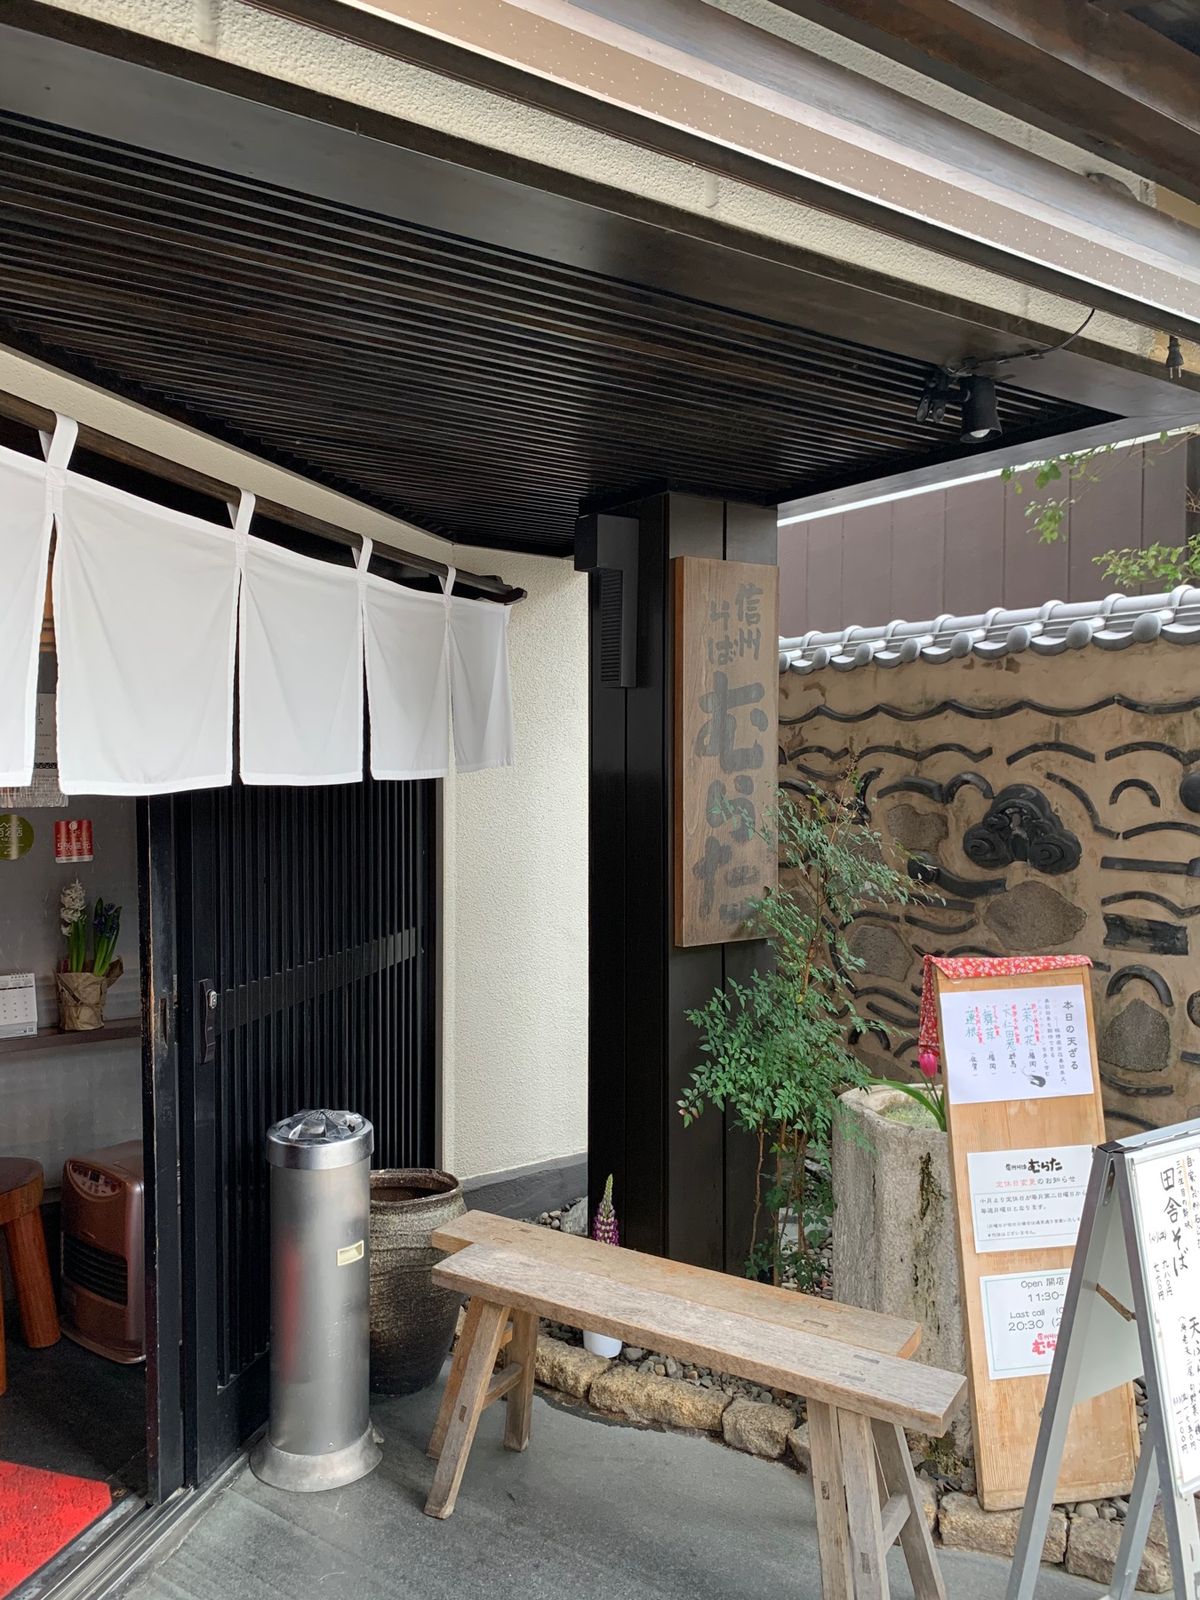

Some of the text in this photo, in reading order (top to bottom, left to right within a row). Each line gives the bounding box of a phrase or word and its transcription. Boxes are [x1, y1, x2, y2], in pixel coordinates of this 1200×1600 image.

[735, 582, 764, 661] 信州
[692, 669, 768, 924] むらた
[1062, 1000, 1079, 1070] 本日の天ざる
[1027, 1157, 1063, 1174] むらた
[1160, 1167, 1189, 1277] 田舎そば
[1020, 1280, 1043, 1289] Open
[1010, 1311, 1030, 1319] Last
[1032, 1308, 1046, 1317] call
[1008, 1319, 1045, 1332] 20:30
[1031, 1339, 1057, 1355] むら
